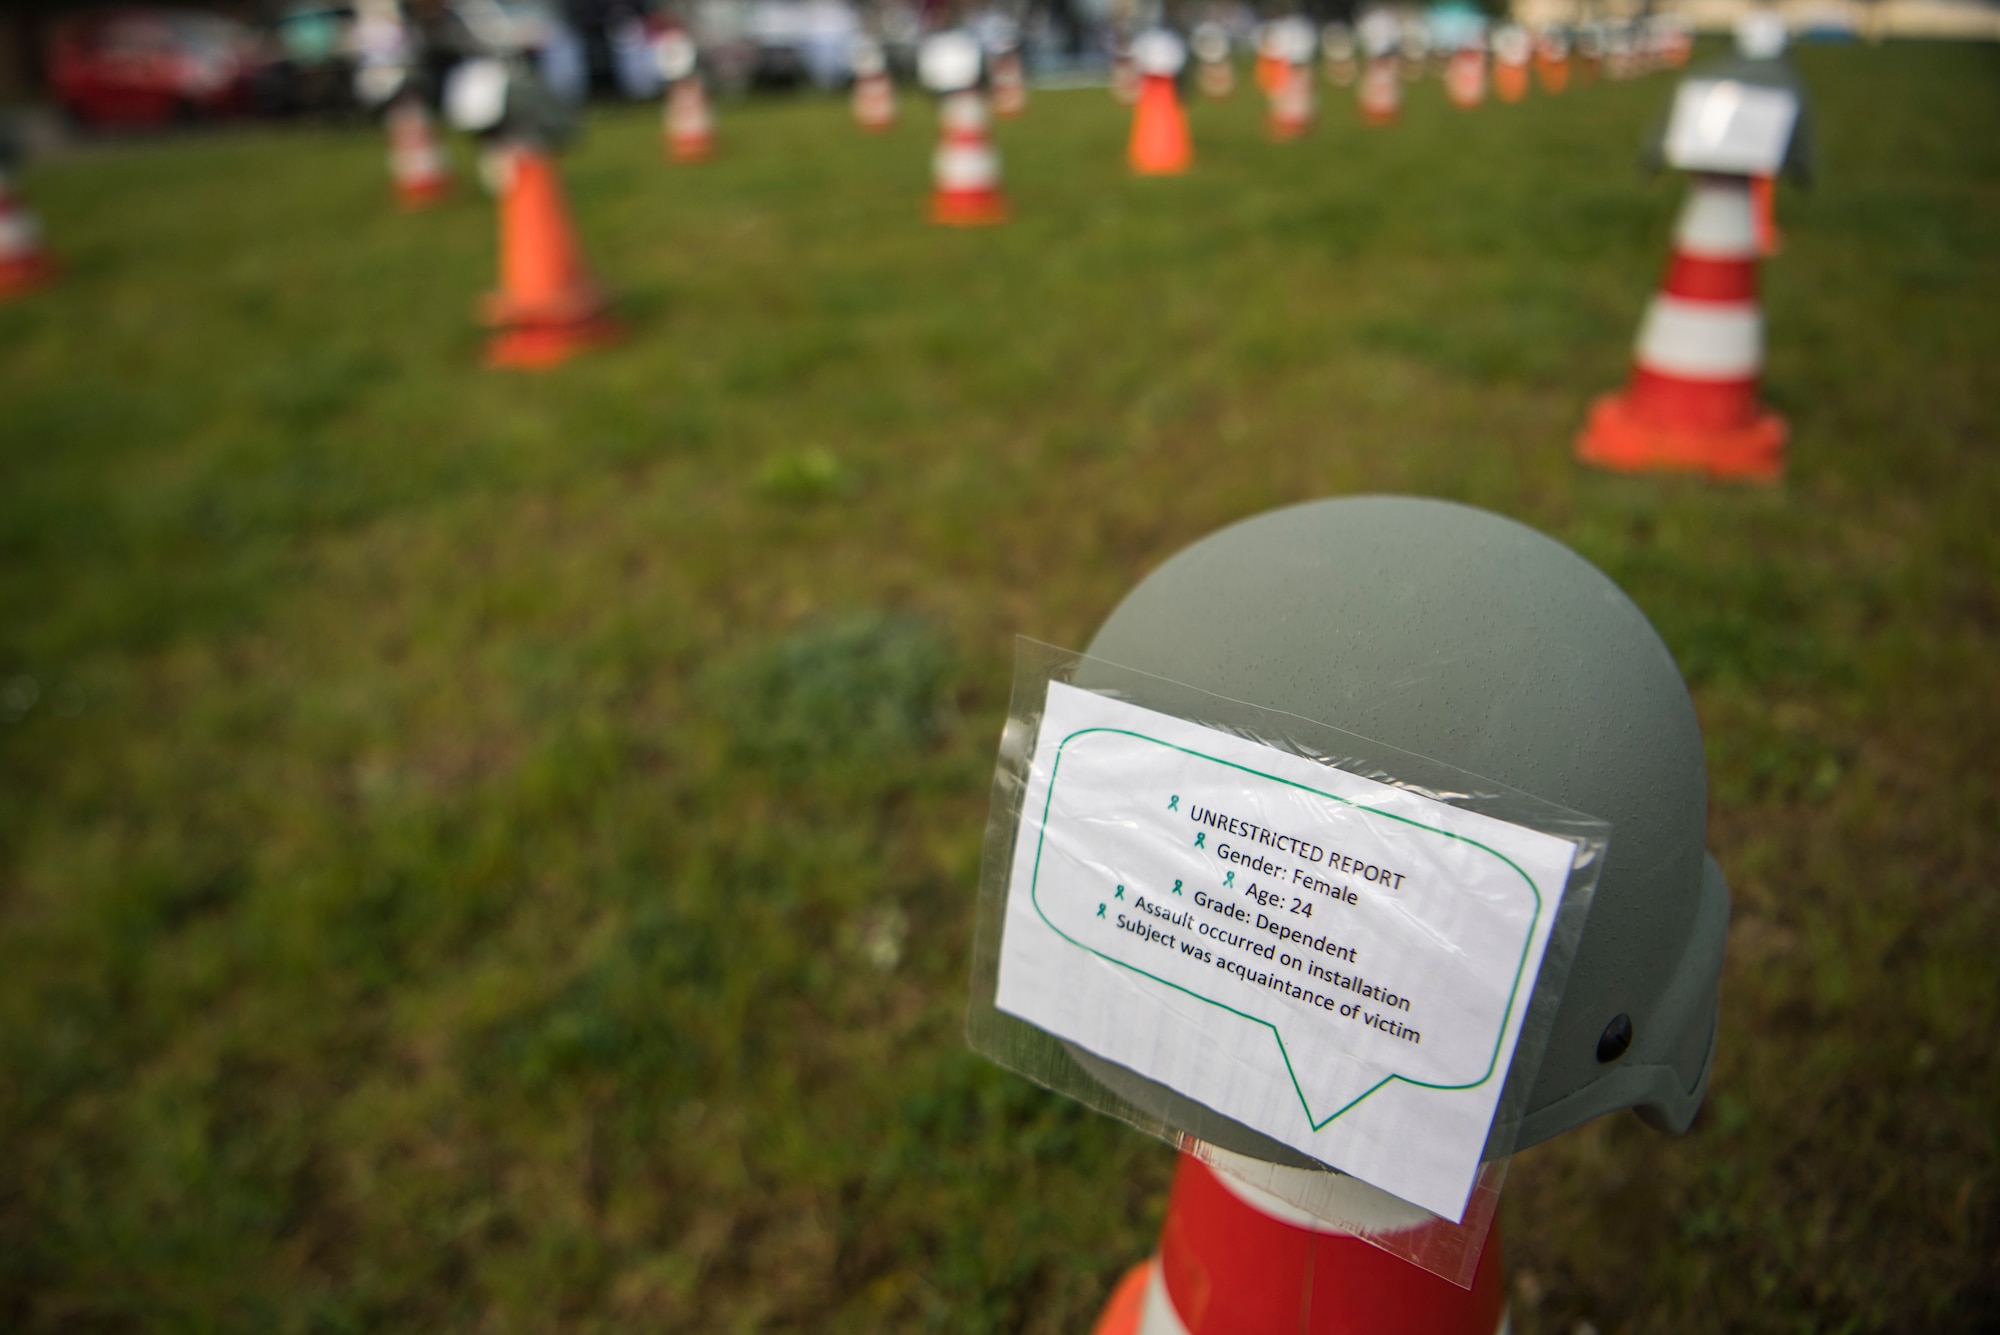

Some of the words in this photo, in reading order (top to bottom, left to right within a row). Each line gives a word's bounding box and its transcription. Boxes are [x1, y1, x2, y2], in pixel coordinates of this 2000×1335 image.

[1217, 844, 1288, 881] Gender:
[1293, 869, 1358, 905] Female
[1245, 883, 1284, 909] Age:
[1290, 898, 1313, 918] 24
[1328, 853, 1406, 890] REPORT
[1135, 896, 1194, 930] Assault
[1199, 921, 1275, 961] occurred
[1280, 952, 1302, 970] on
[1308, 961, 1410, 1011] installation
[1194, 891, 1250, 923] Grade:
[1256, 914, 1357, 963] Dependent
[1117, 914, 1176, 949] Subject
[1181, 940, 1211, 964] was
[1216, 957, 1335, 1011] acquaintance
[1340, 1002, 1361, 1020] of
[1364, 1011, 1421, 1044] victim
